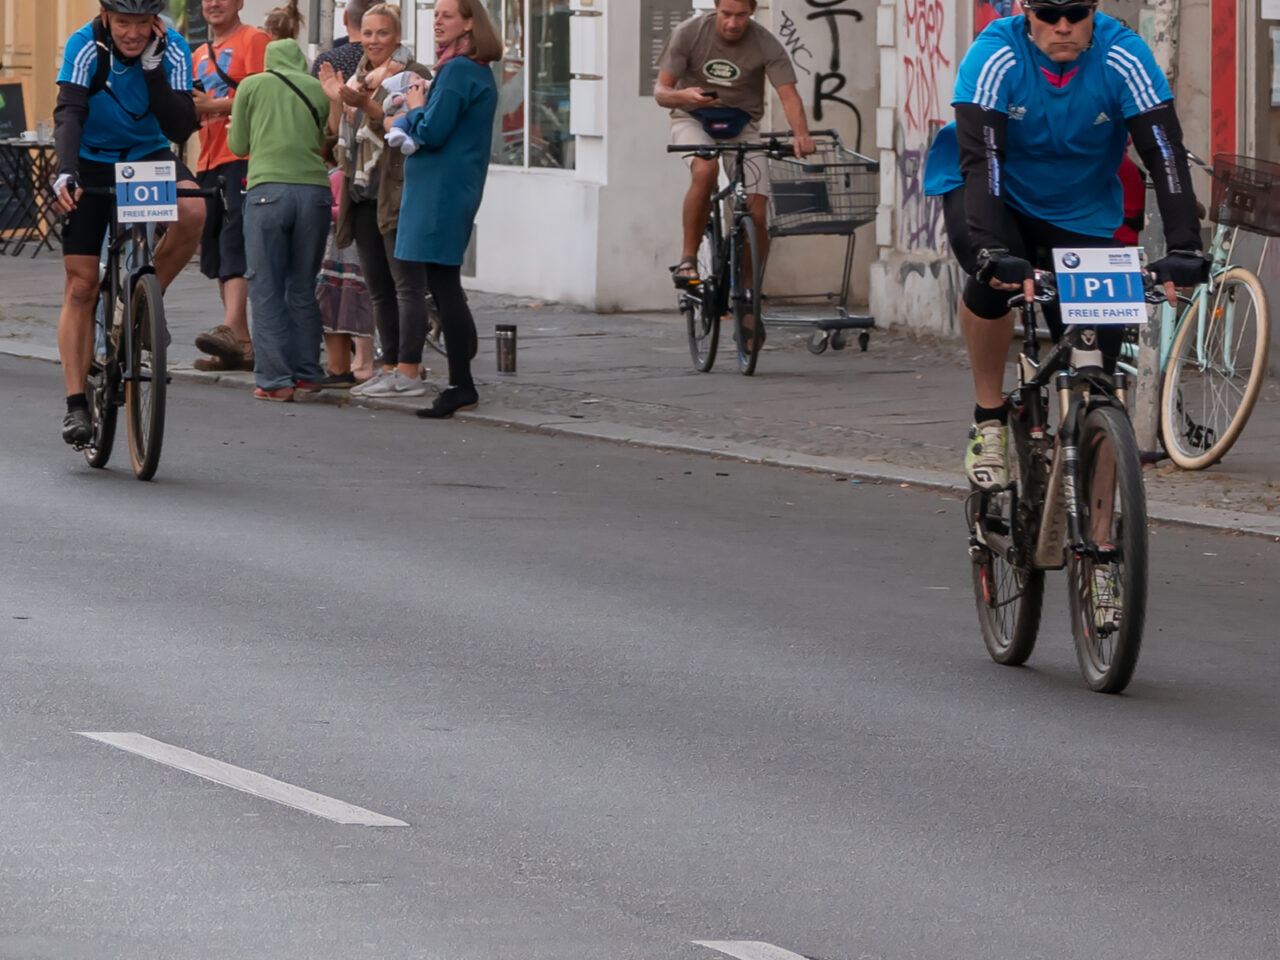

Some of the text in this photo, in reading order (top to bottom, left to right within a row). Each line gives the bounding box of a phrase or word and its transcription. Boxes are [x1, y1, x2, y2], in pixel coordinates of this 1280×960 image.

[147, 209, 173, 217] FAHRT
[1084, 278, 1115, 298] P1
[1068, 308, 1140, 318] FREIE FAHRT
